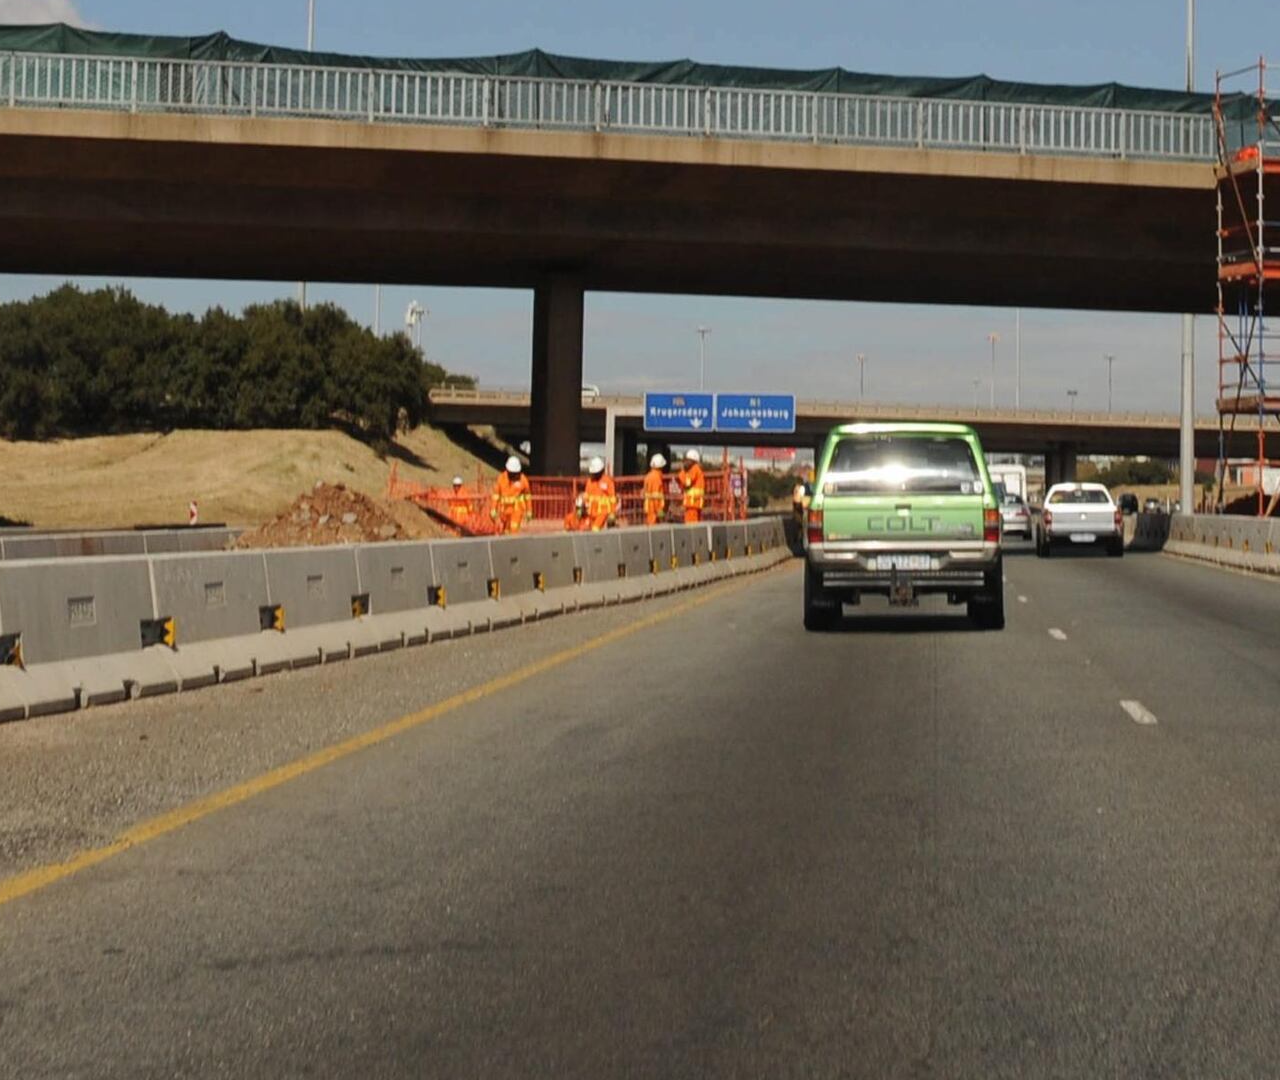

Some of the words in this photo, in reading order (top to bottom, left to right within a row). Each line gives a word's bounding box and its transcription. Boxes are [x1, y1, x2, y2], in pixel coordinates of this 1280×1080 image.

[650, 407, 708, 418] Krugersdorp
[722, 408, 789, 420] Johannesburg
[867, 516, 940, 531] COLT
